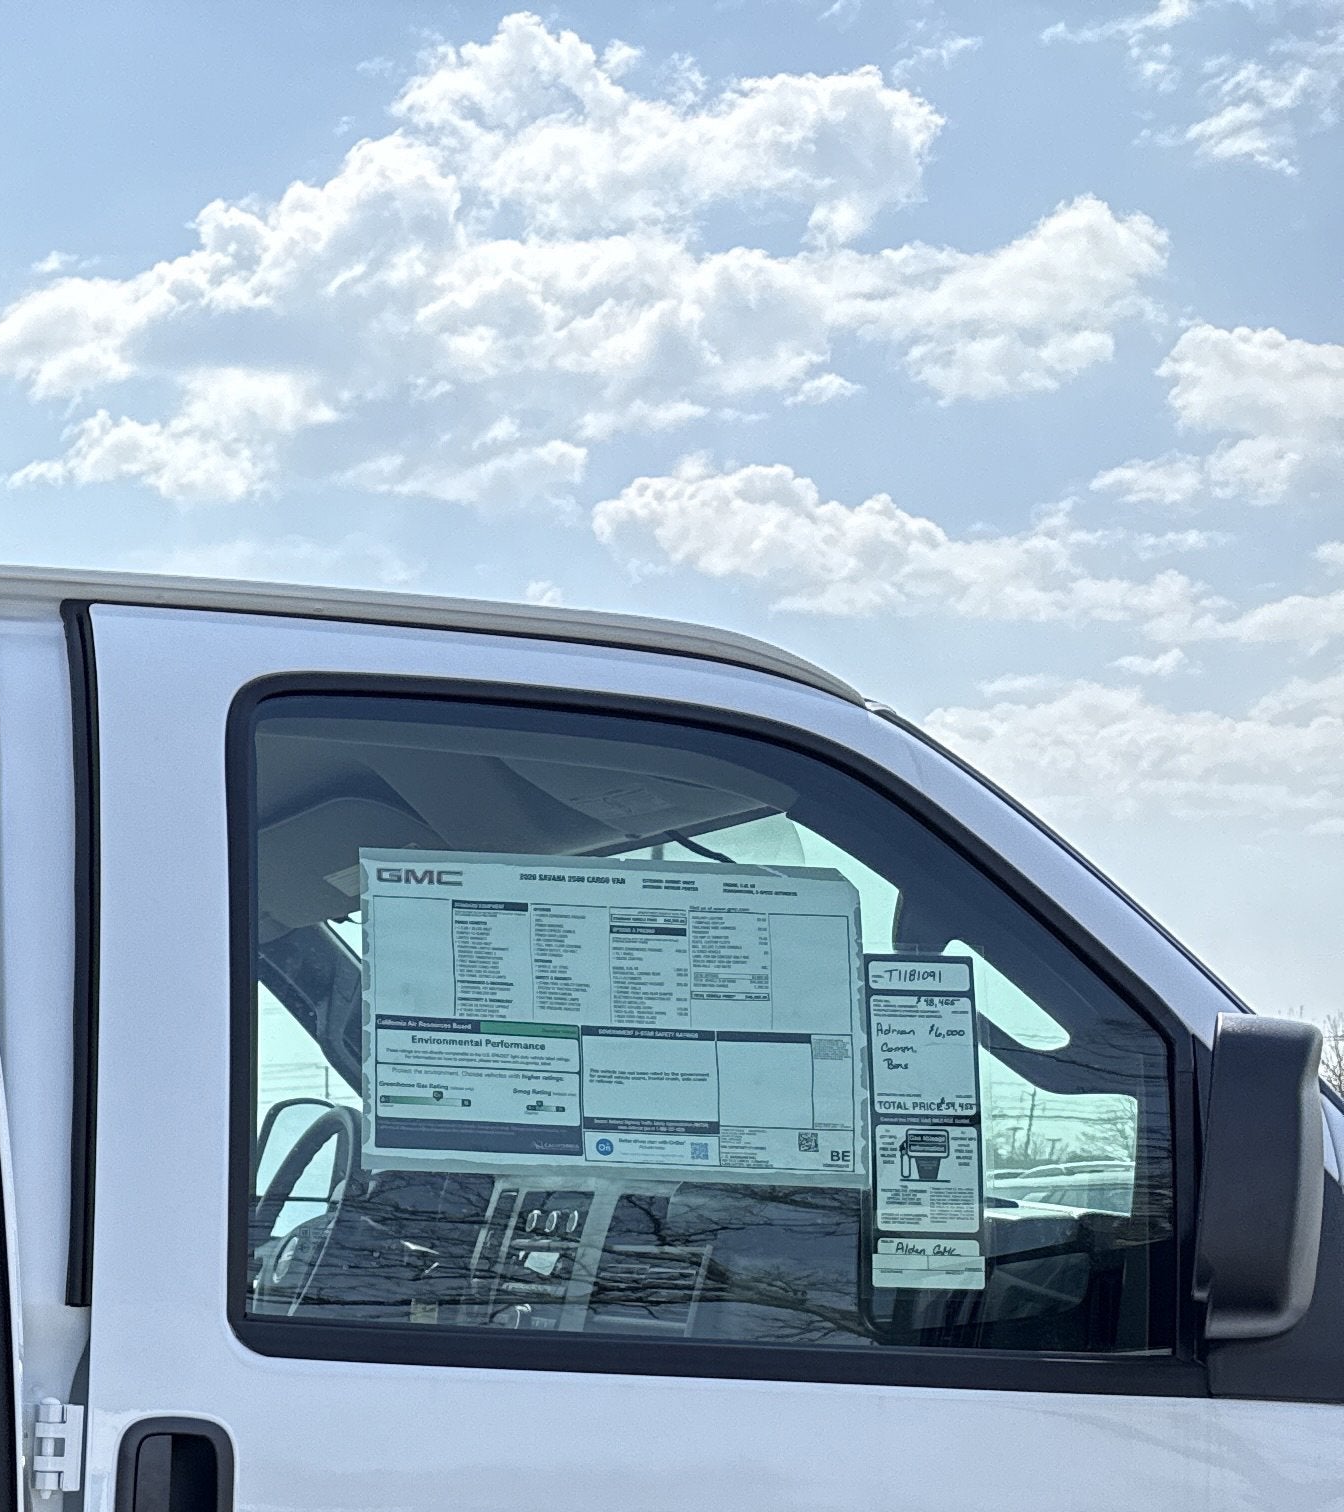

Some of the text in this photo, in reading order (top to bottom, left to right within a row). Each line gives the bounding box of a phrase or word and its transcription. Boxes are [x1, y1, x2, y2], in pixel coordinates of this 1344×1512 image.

[376, 868, 463, 887] GMC
[407, 1019, 417, 1027] Air
[452, 1022, 472, 1030] Board
[411, 1034, 546, 1051] Environmental Performance
[522, 1073, 541, 1081] higher
[379, 1080, 415, 1088] Greenhouse
[429, 1083, 448, 1091] Rating
[513, 1087, 531, 1096] Smog
[532, 1088, 552, 1097] Rating
[877, 1100, 944, 1111] TOTAL PRICE
[831, 1150, 851, 1162] BE
